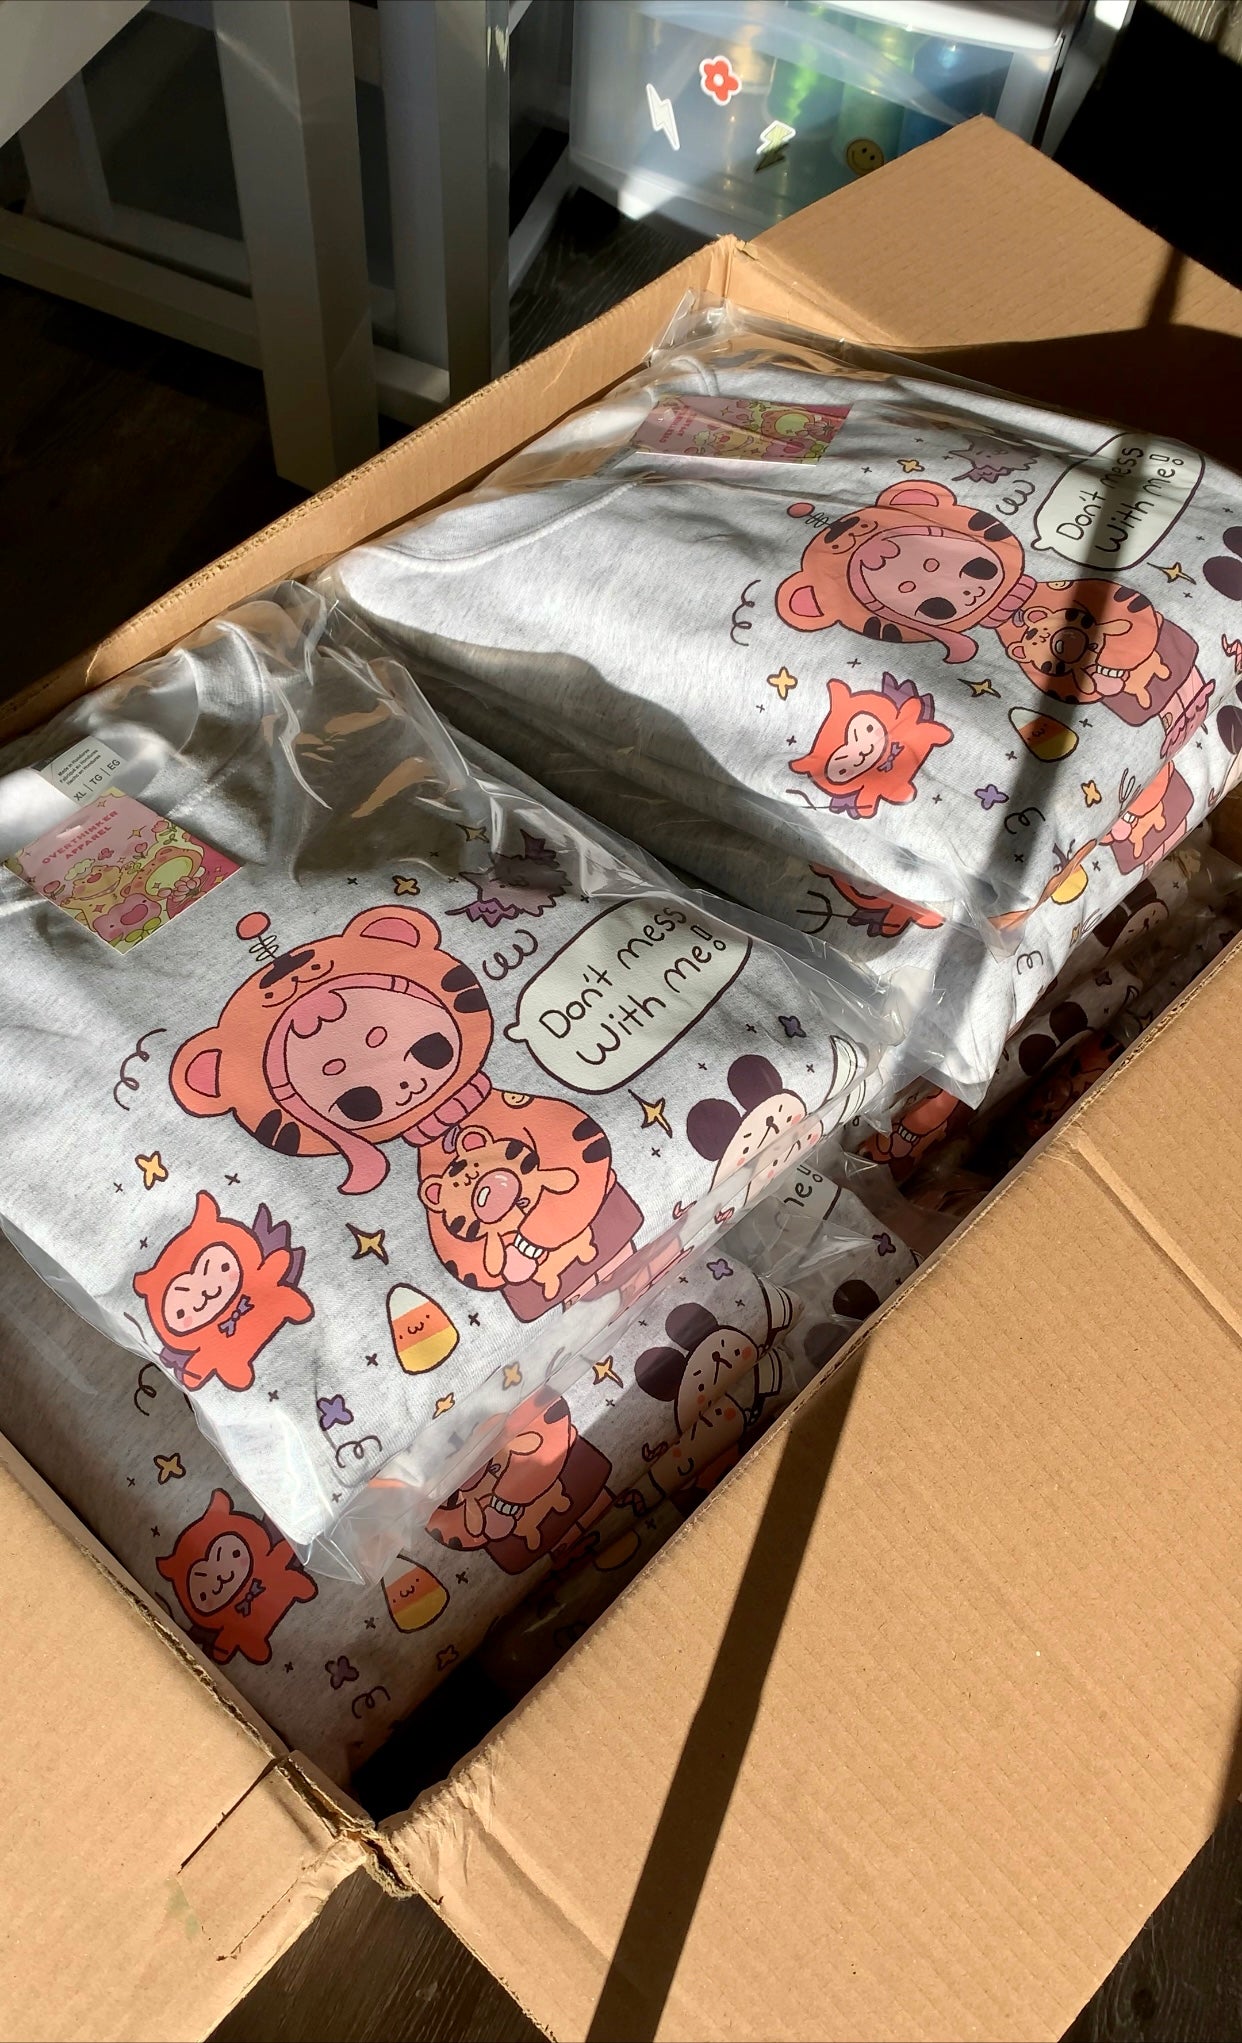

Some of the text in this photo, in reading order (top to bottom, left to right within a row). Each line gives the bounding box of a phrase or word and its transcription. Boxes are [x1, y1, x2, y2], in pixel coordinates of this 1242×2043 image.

[1056, 447, 1146, 542] Don't mess
[1143, 453, 1185, 497] me!
[73, 759, 121, 801] XL TG EG
[42, 811, 118, 864] OVERTHINKER
[66, 826, 112, 859] APPAREL
[539, 907, 687, 1039] Don't mess
[664, 924, 727, 993] me!
